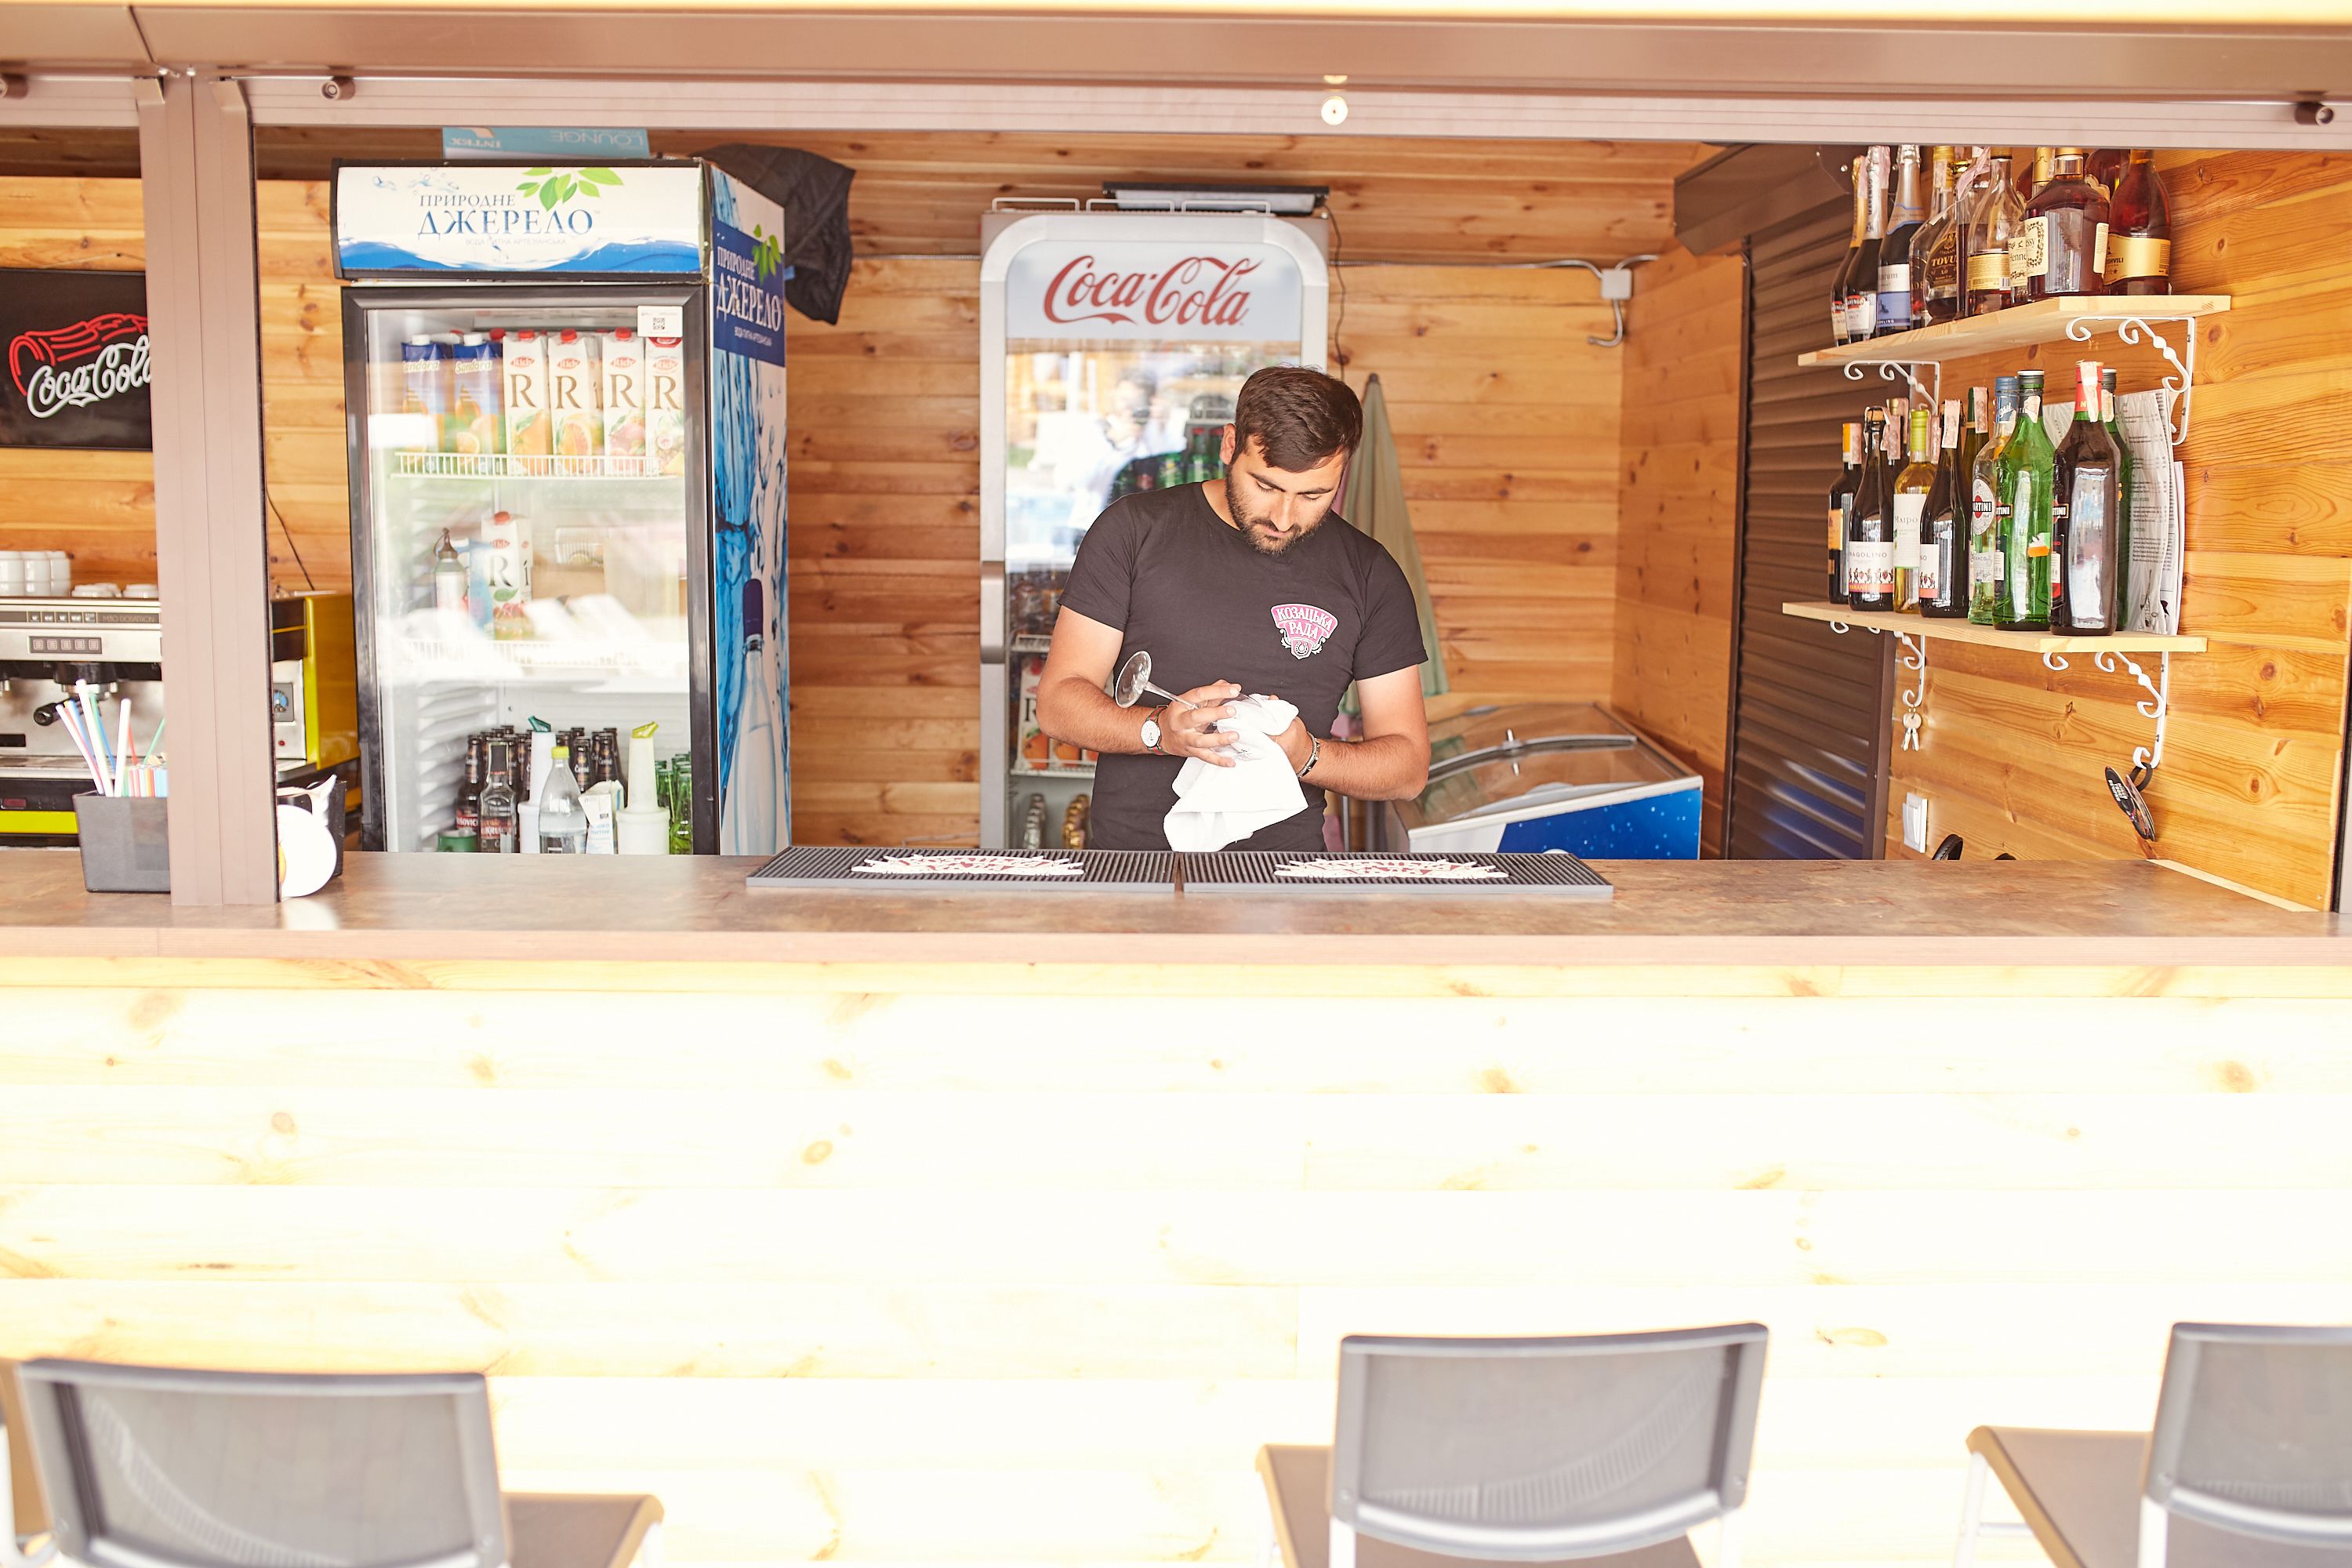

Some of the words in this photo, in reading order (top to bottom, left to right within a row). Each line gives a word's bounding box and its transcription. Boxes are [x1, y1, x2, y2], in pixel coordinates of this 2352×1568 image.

[419, 194, 515, 207] ПРИРОДНЕ
[418, 209, 593, 241] ДЖЕРЕЛО
[717, 245, 756, 281] ПРИРОДНЕ
[1931, 255, 1956, 267] TOVU
[716, 272, 782, 332] ДЖЕРЕЛО
[1044, 254, 1265, 326] Coca-Cola
[455, 358, 493, 375] Sandora
[510, 374, 537, 408] R
[555, 376, 583, 409] R
[610, 374, 638, 408] R
[653, 376, 681, 409] R
[1973, 502, 1992, 512] ARTINI
[1276, 606, 1334, 630] КОЗАЦЬКА
[1288, 622, 1319, 640] РАДА
